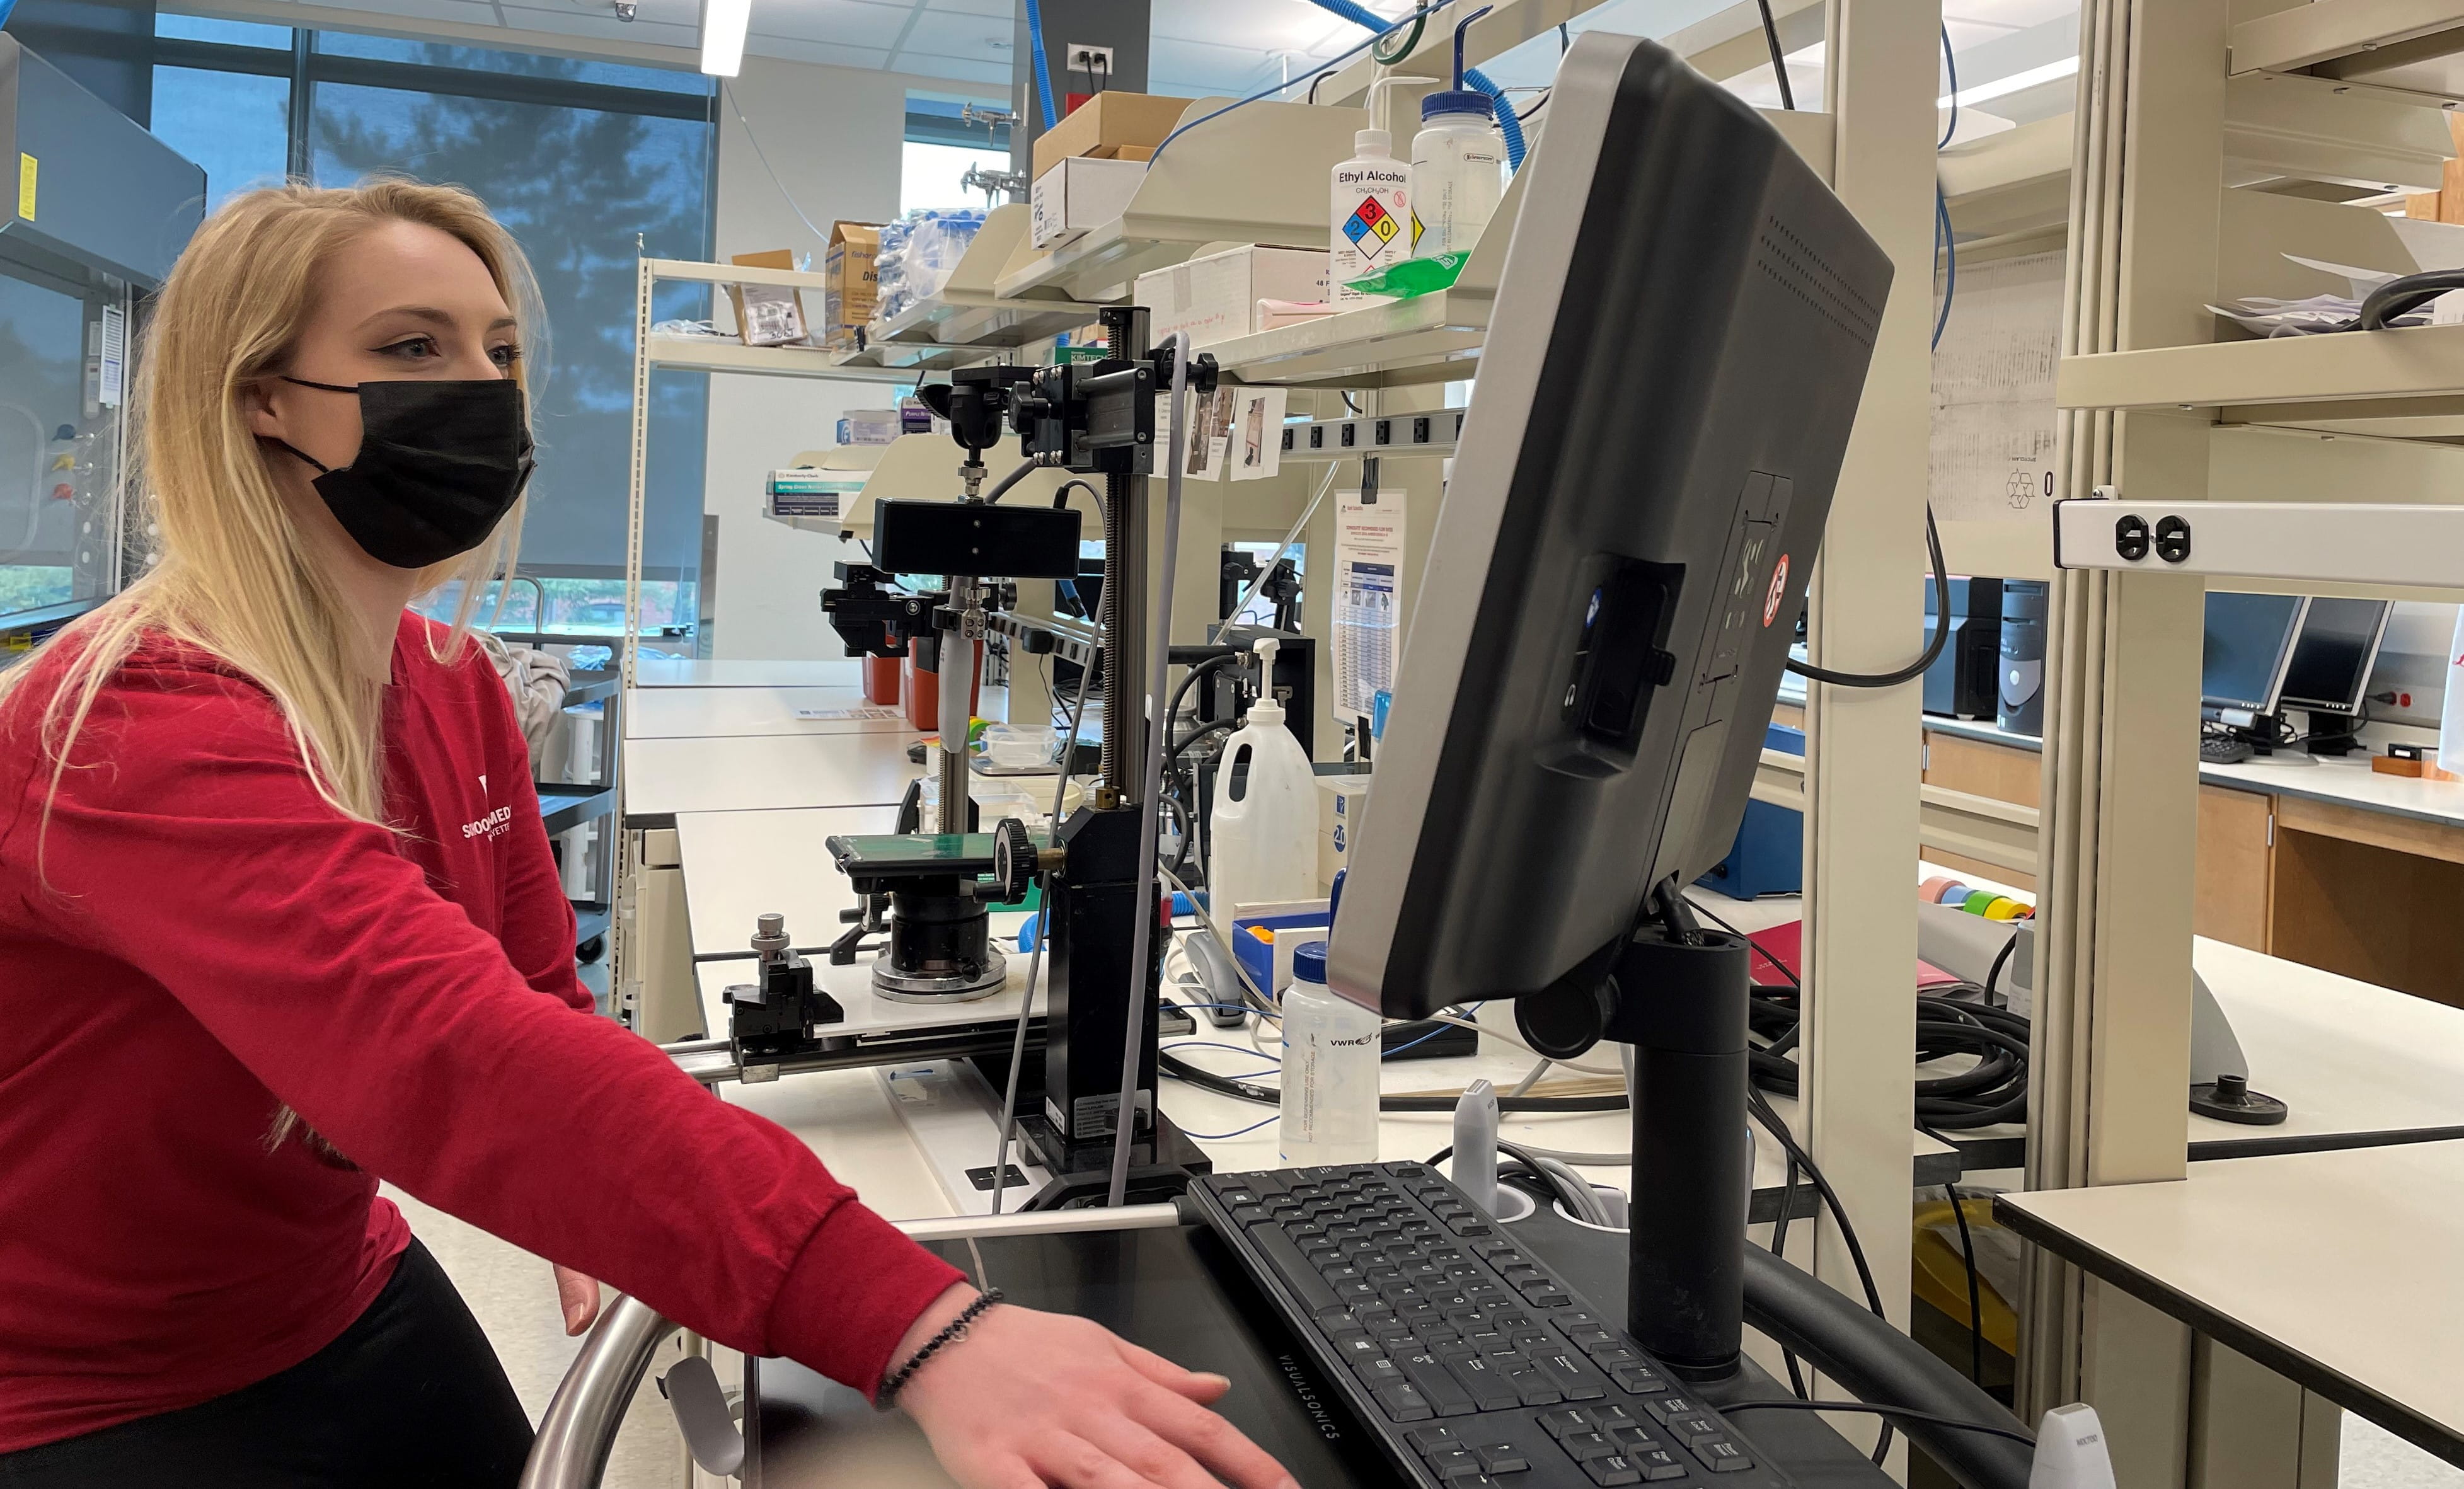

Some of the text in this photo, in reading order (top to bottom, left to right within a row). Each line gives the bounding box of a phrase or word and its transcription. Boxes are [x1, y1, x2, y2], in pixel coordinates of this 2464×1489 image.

[1339, 171, 1406, 183] Ethyl Alcohol
[1364, 203, 1376, 219] 3
[1350, 221, 1391, 236] 2 0
[1640, 1368, 1652, 1376] F12
[1279, 1355, 1340, 1439] VISUALSONICS
[1591, 1433, 1603, 1442] End
